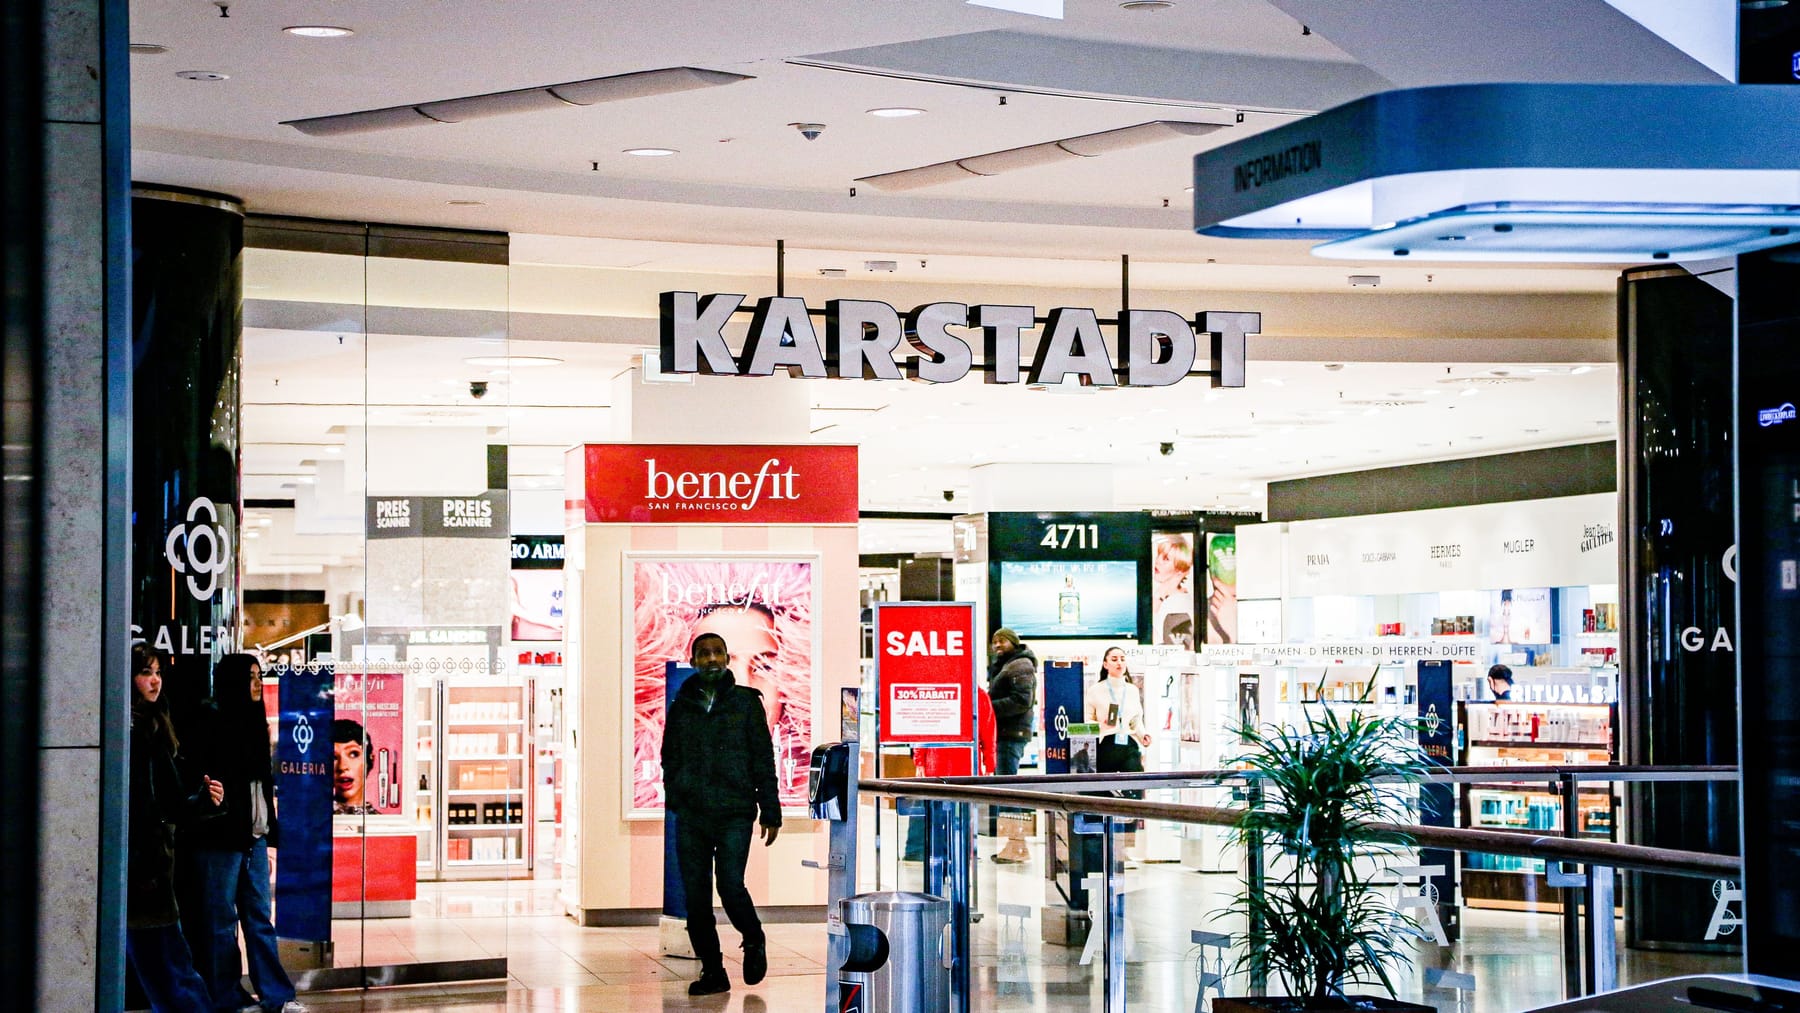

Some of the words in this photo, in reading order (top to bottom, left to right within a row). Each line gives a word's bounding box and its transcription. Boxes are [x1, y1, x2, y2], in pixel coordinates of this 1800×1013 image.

[1234, 141, 1322, 193] INFORMATION
[660, 291, 1261, 388] KARSTADT
[644, 458, 800, 510] benefit
[376, 500, 410, 517] PREIS
[443, 500, 492, 517] PREIS
[648, 502, 670, 510] SAN
[675, 502, 737, 510] FRANCISCO
[376, 517, 410, 528] SCANNER
[443, 517, 492, 527] SCANNER
[1040, 524, 1099, 549] 4711
[509, 543, 530, 558] IO
[1503, 539, 1535, 553] MUGLER
[1307, 553, 1330, 566] PRADA
[662, 572, 785, 614] benefit
[886, 631, 964, 656] SALE
[1680, 626, 1734, 652] GA
[1263, 647, 1301, 656] DAMEN
[1322, 646, 1364, 656] HERREN
[1389, 646, 1433, 656] HERREN
[1442, 643, 1476, 656] DÜFTE
[897, 690, 918, 699] 30%
[919, 690, 955, 699] RABATT
[280, 761, 327, 776] GALERIA
